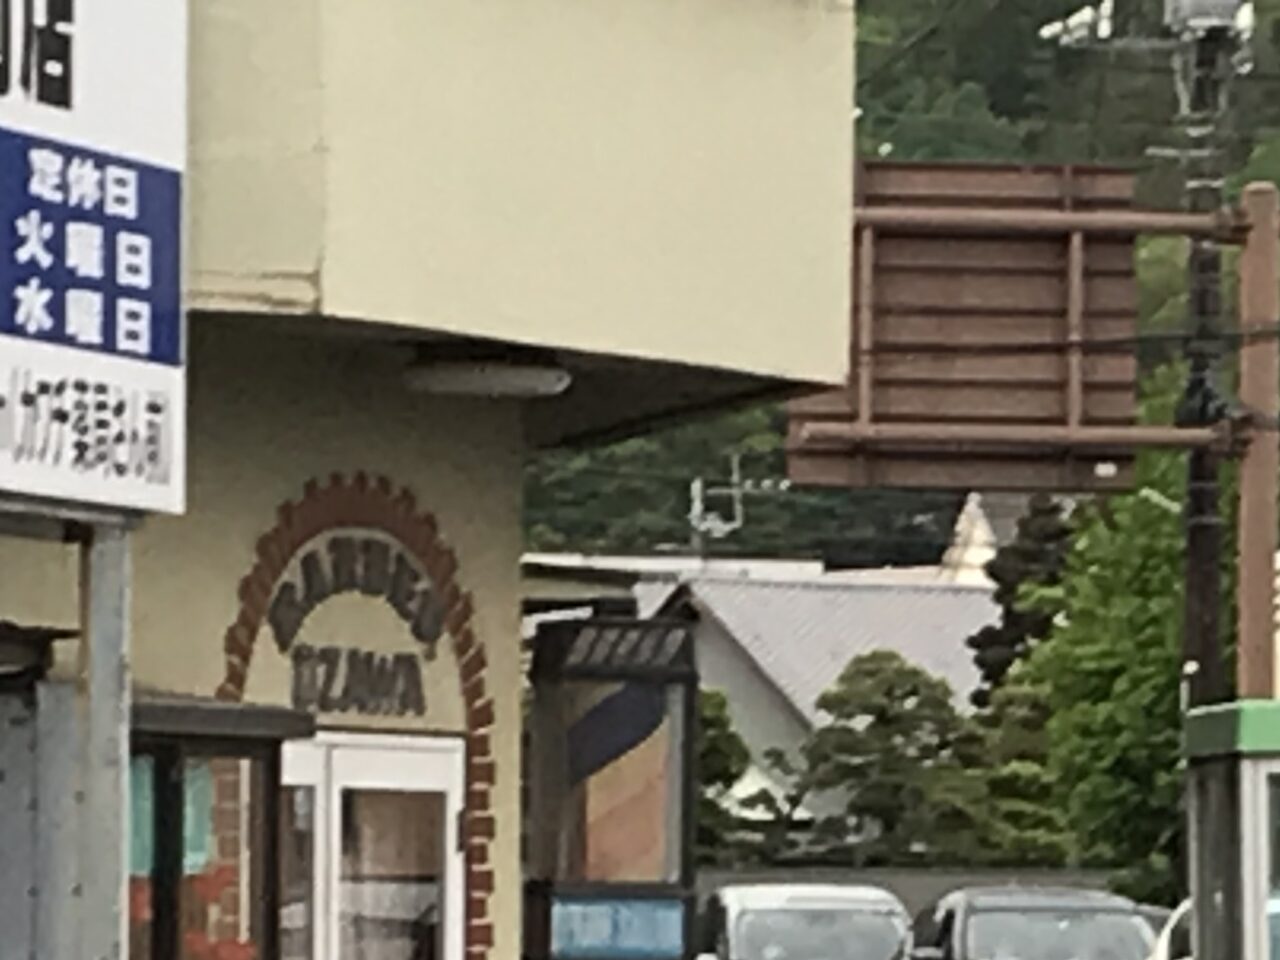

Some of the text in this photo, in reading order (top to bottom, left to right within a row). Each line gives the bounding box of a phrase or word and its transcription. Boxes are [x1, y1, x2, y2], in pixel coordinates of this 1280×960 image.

[0, 0, 73, 111] 店
[28, 148, 139, 220] 定休日
[14, 209, 152, 289] 火曜日
[13, 277, 152, 354] 水曜日
